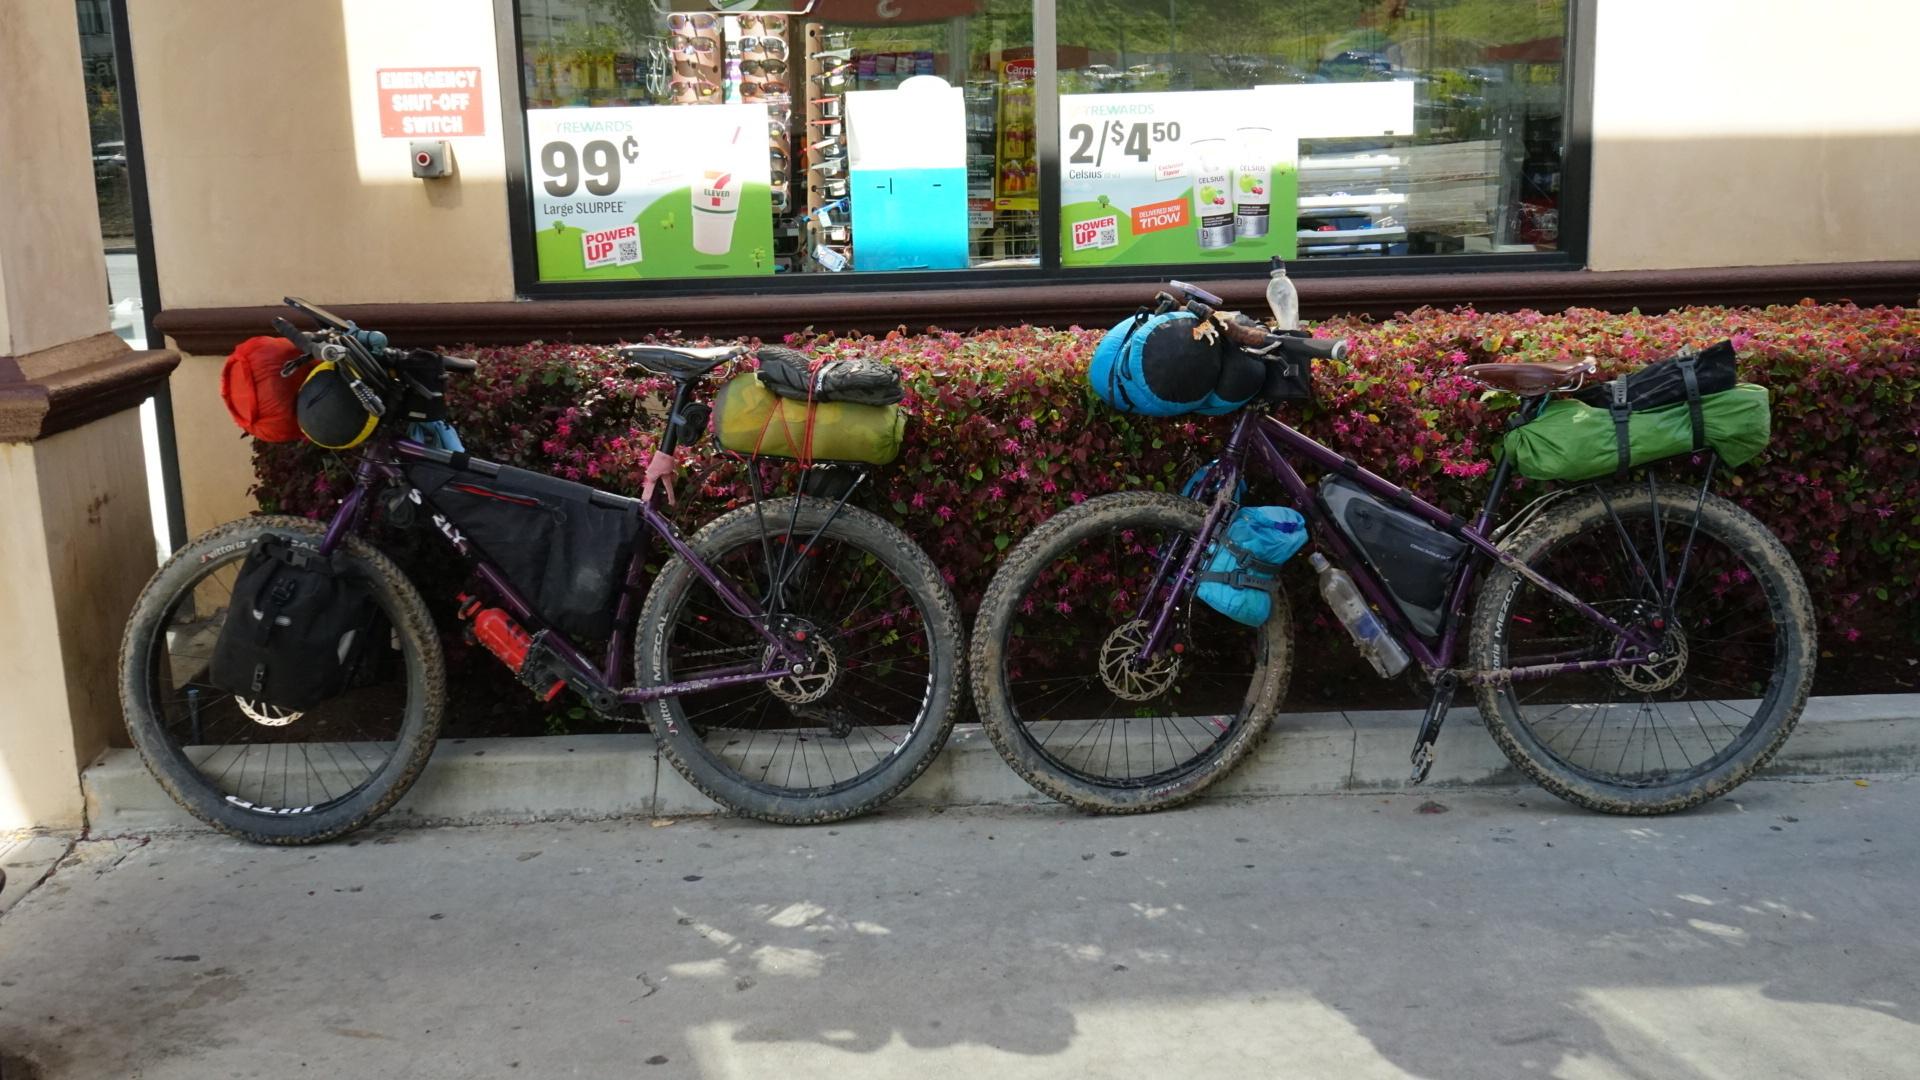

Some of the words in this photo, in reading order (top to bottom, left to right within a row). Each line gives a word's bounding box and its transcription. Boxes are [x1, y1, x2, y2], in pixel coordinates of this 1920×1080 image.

[380, 71, 477, 89] EMERGENCY
[391, 92, 470, 112] SHUT-OFF
[402, 115, 464, 134] SWITCH
[541, 135, 640, 198] 99¢
[1069, 169, 1102, 180] Celsius
[1199, 175, 1225, 184] CELSIUS
[543, 203, 575, 218] Large
[576, 201, 624, 214] SLURPEE
[1138, 207, 1168, 218] DELIVERED
[1168, 204, 1181, 212] NOW
[1075, 217, 1115, 233] POWER
[586, 226, 636, 245] POWER
[1076, 230, 1097, 245] UP
[587, 242, 614, 261] UP
[653, 612, 670, 681] MEZCAL
